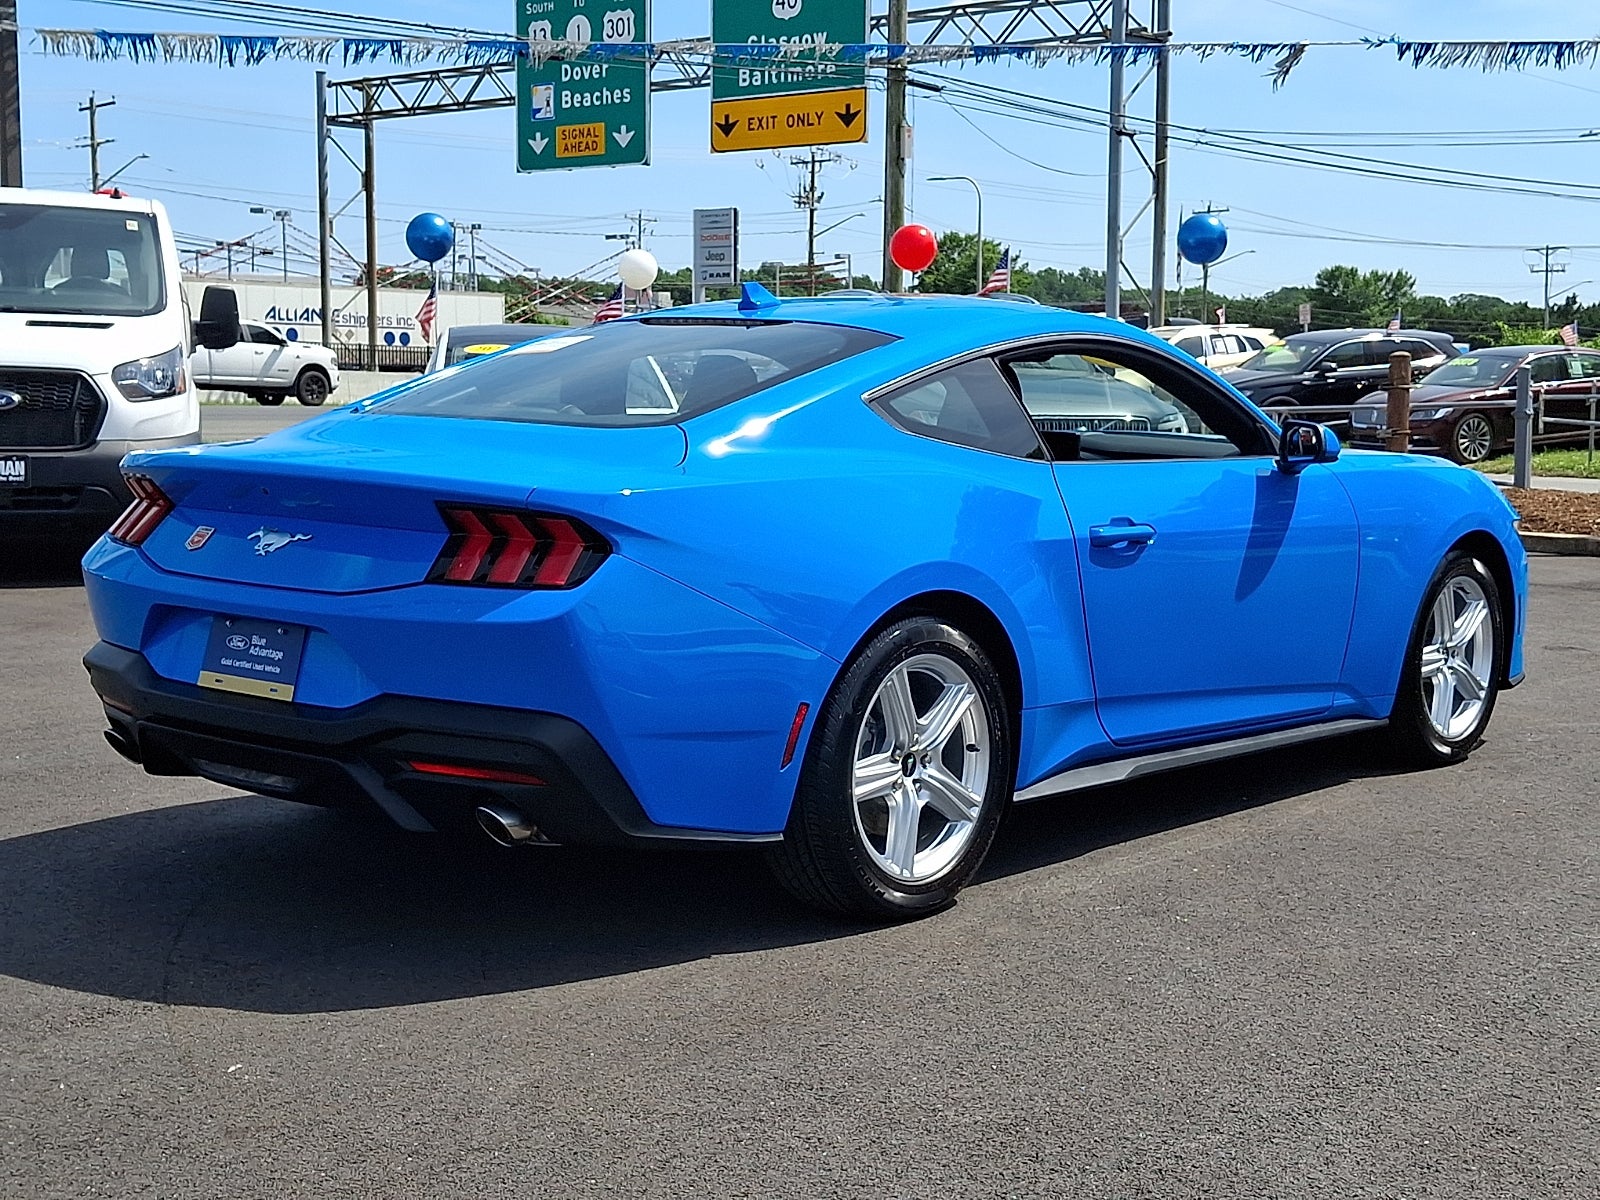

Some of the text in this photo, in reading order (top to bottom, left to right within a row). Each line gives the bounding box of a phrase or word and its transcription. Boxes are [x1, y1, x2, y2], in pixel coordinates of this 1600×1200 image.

[525, 2, 554, 14] SOUTH
[575, 24, 581, 42] 1
[606, 17, 631, 39] 301
[561, 64, 609, 82] Dover
[738, 64, 837, 87] Baltimore
[561, 87, 631, 109] Beaches
[747, 111, 824, 132] EXIT ONLY
[561, 127, 599, 140] SIGNAL
[562, 140, 598, 154] AHEAD
[705, 250, 725, 262] Jeep
[265, 305, 416, 328] ALLIANE shipers inc.
[251, 635, 267, 646] Blue
[249, 645, 284, 661] Advantage
[221, 657, 232, 666] Gold
[233, 659, 252, 669] Certified
